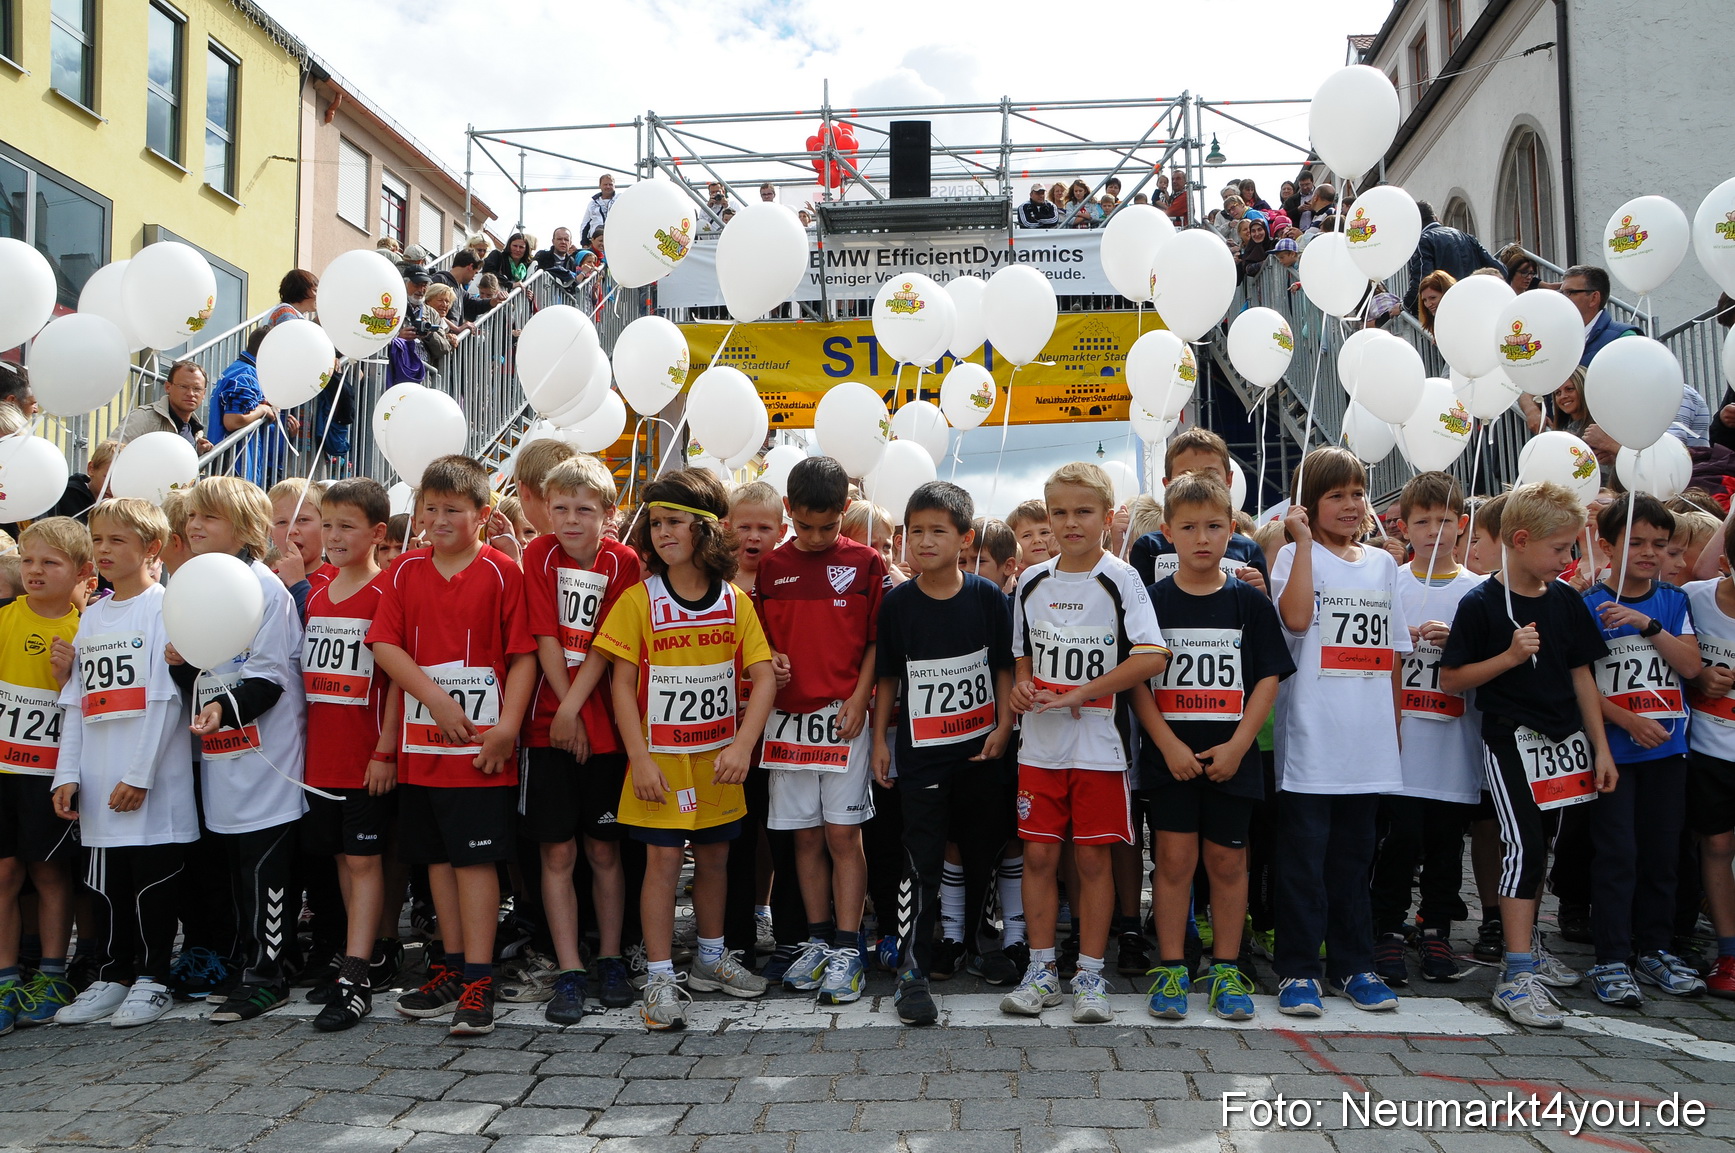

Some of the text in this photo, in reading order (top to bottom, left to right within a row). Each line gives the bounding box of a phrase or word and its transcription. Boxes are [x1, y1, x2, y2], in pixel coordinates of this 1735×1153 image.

[810, 245, 1084, 268] BMW EfficientDynamics
[810, 273, 871, 287] Weniger
[742, 359, 791, 370] Stadtlauf
[1038, 351, 1101, 362] Neumarkter
[833, 599, 847, 607] MD
[1322, 597, 1388, 609] PARTL Neumarkt
[325, 626, 361, 636] Neumarkt
[1031, 627, 1100, 645] PARTL Neumarkt
[1331, 612, 1389, 646] 7391
[86, 640, 128, 653] Neumarkt
[653, 629, 736, 652] MAX BÖGL
[1181, 638, 1230, 648] Neumarkt
[306, 637, 361, 671] 7091
[1034, 642, 1104, 681] 7108
[79, 654, 135, 691] 295
[910, 661, 981, 679] PARTL Neumarkt
[311, 677, 341, 693] Kilian
[432, 676, 481, 686] Neumarkt
[651, 673, 725, 685] PARTL Neumarkt
[917, 673, 988, 715] 7238
[1176, 694, 1217, 709] Robin
[1405, 693, 1439, 709] Felix
[659, 686, 728, 722] 7283
[941, 717, 978, 735] Julian
[673, 725, 720, 744] Samuel
[4, 747, 30, 763] Jan
[771, 746, 839, 762] Maximilian
[1526, 739, 1589, 779] 7388
[477, 839, 492, 847] JAKO
